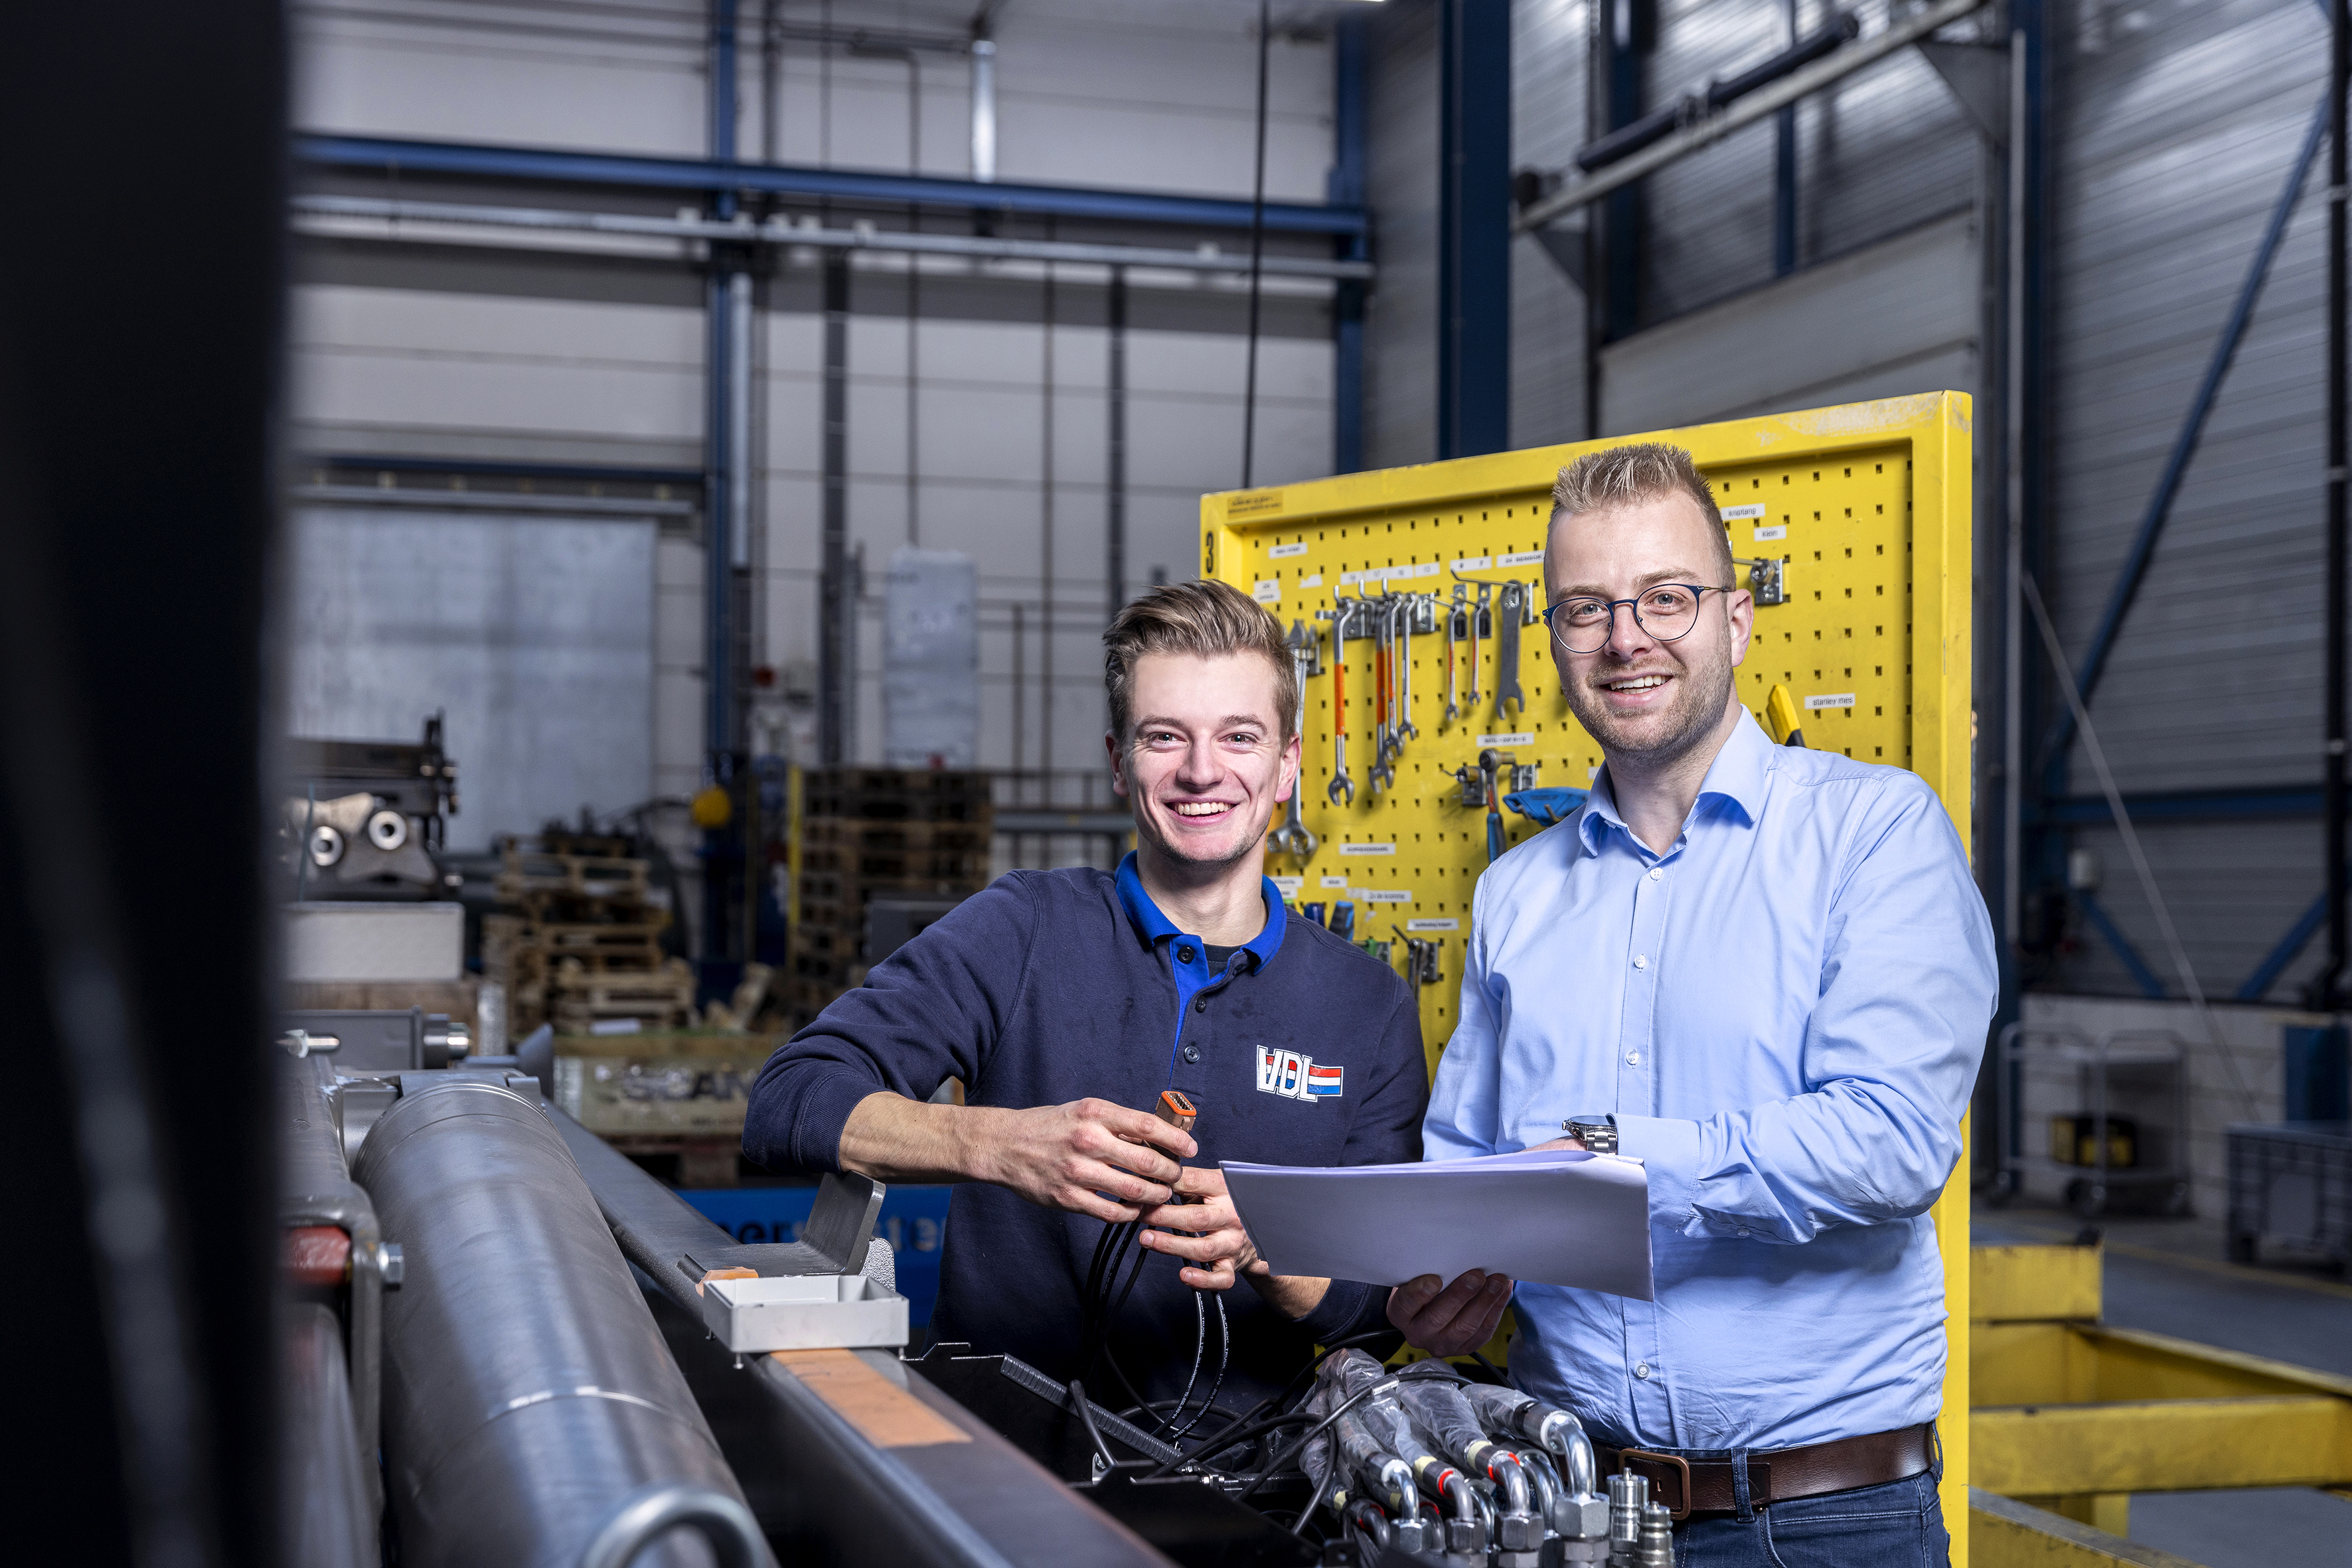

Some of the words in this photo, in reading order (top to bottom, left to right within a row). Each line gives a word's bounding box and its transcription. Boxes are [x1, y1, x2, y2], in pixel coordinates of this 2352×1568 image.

[1206, 532, 1214, 573] 3
[1812, 697, 1837, 706] stanley
[1257, 1045, 1318, 1102] VDL
